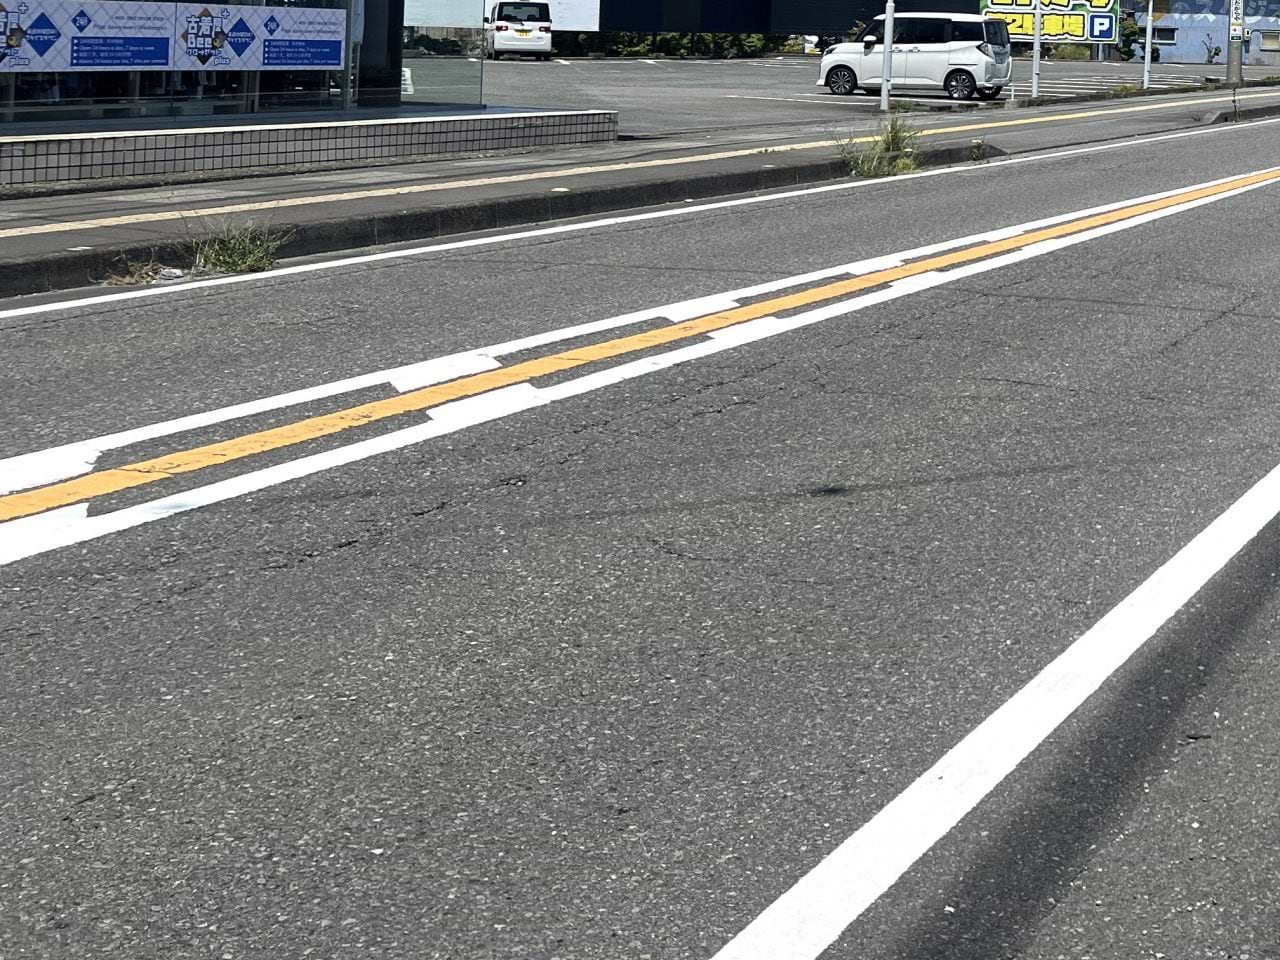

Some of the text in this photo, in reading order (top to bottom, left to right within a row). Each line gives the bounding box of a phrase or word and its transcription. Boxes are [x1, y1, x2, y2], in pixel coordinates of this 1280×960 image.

[1093, 18, 1110, 36] P
[9, 56, 30, 67] plus
[214, 56, 231, 66] plus
